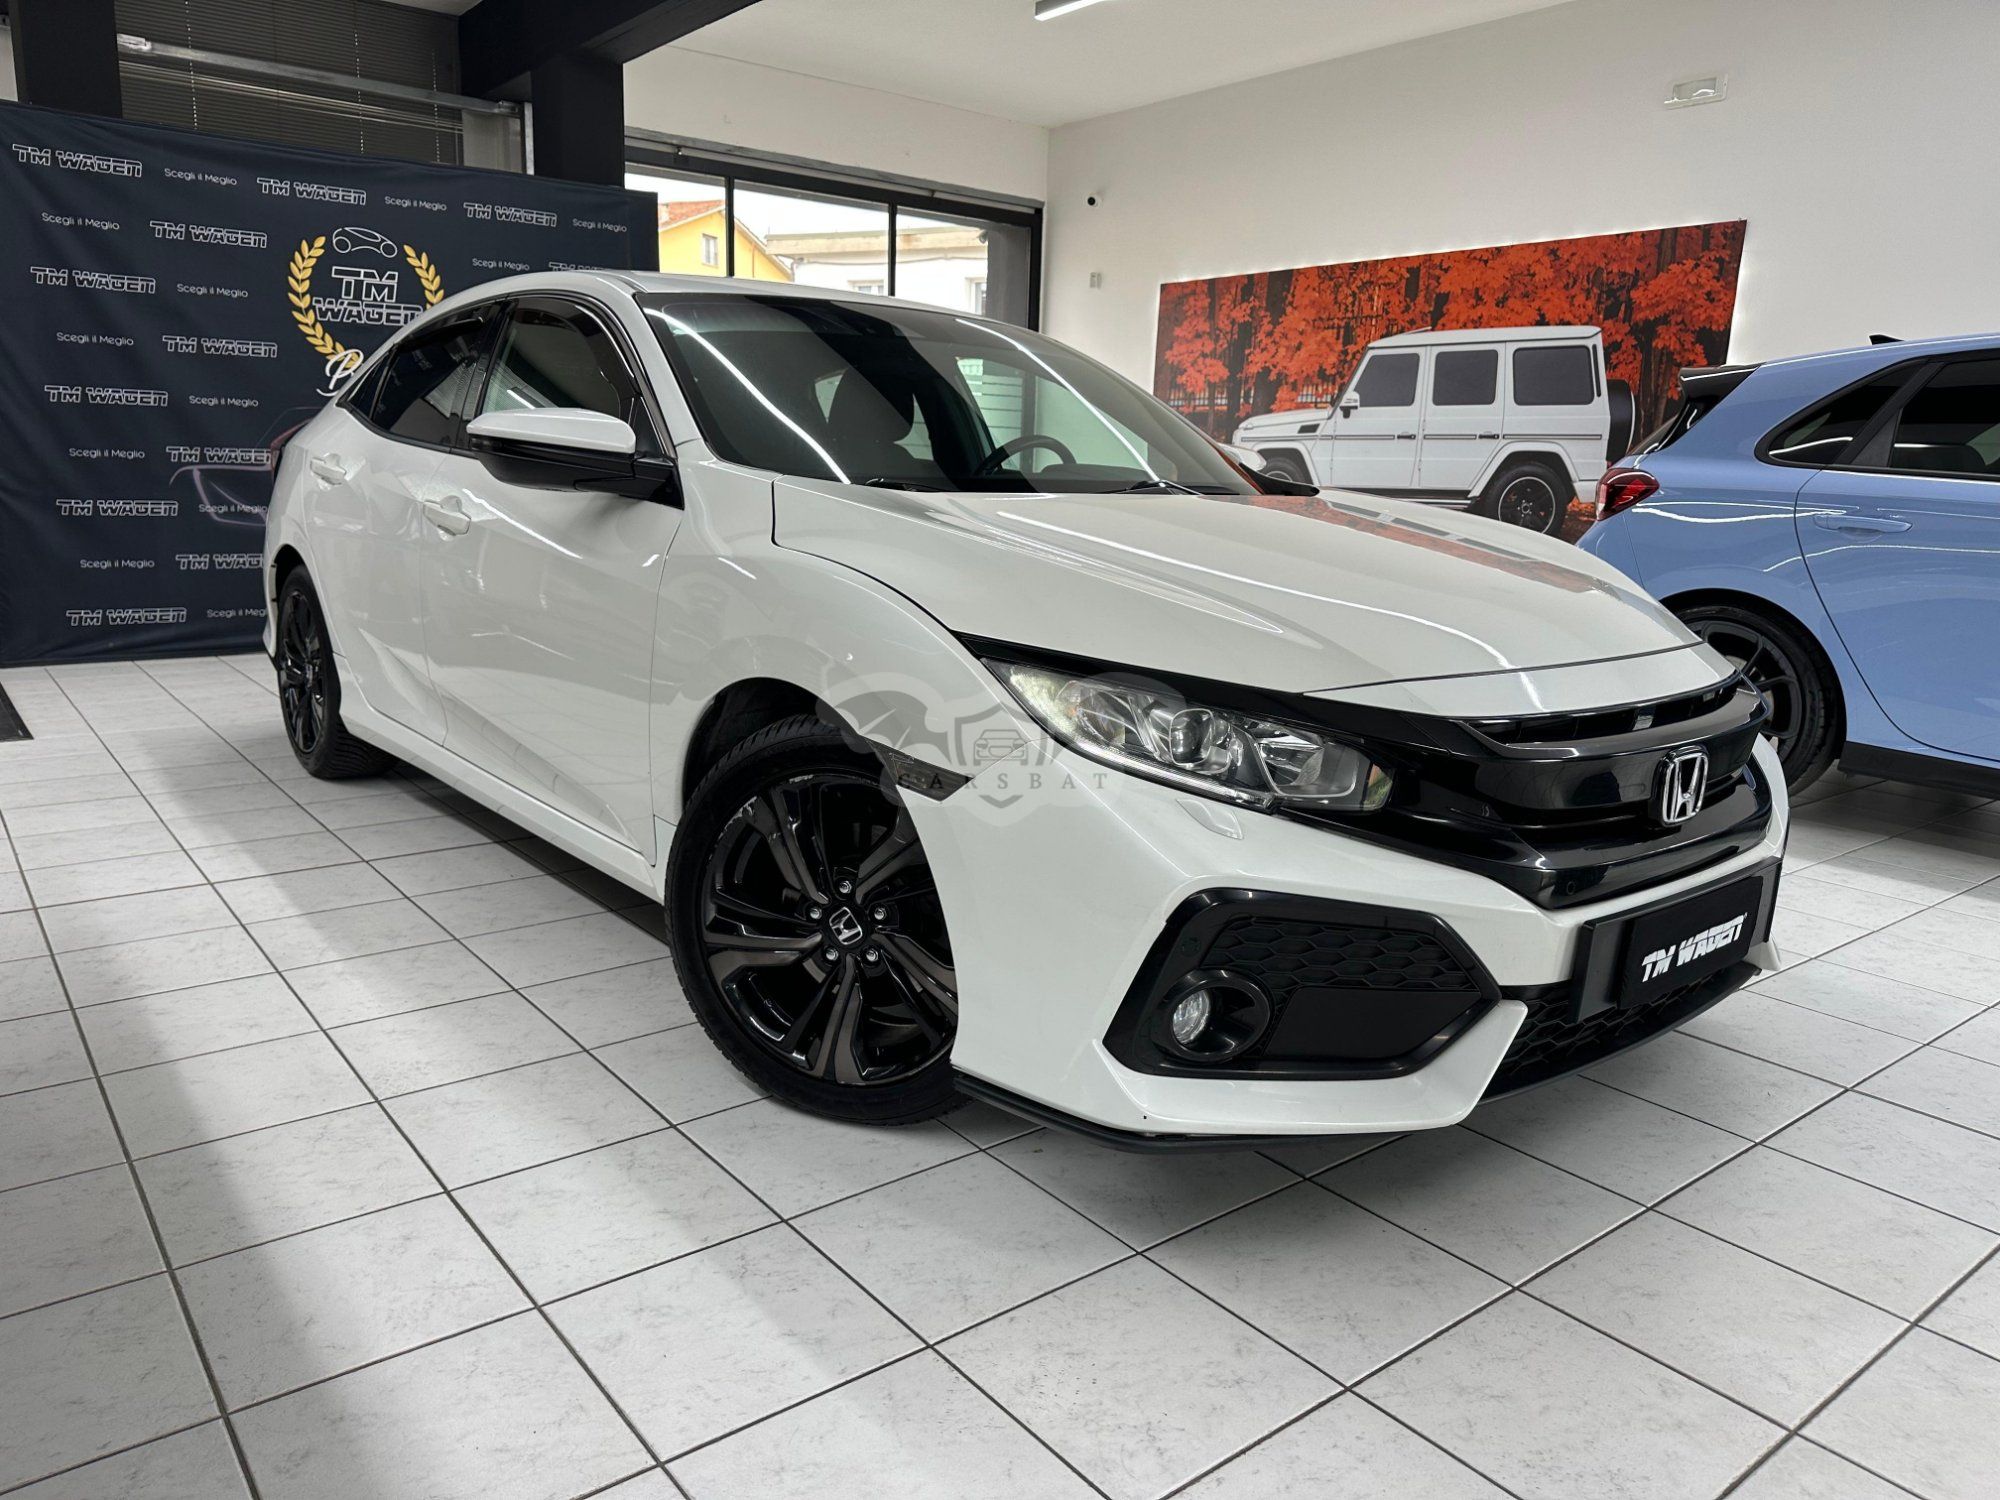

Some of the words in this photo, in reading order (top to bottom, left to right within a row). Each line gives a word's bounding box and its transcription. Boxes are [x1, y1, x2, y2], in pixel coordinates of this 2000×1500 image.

[12, 144, 51, 166] TM
[56, 150, 142, 177] WAGEN
[165, 168, 195, 181] Scegli
[205, 174, 237, 185] Meglio
[257, 177, 290, 196] TM
[294, 182, 366, 205] WAGEN
[385, 196, 411, 207] Scegli
[419, 201, 447, 211] Meglio
[42, 212, 74, 225] Scegli
[85, 219, 119, 230] Meglio
[463, 202, 492, 219] TM
[494, 206, 557, 227] WAGEN
[573, 219, 596, 229] Scegli
[602, 223, 627, 232] Meglio
[150, 221, 185, 240] TM
[189, 225, 267, 248] WAGEN
[473, 258, 497, 268] Scegli
[504, 262, 530, 271] Meglio
[30, 267, 68, 286] TM
[72, 270, 156, 294] WAGEN
[331, 266, 399, 302] TM
[177, 284, 207, 295] Scegli
[217, 288, 248, 298] Meglio
[57, 332, 89, 344] Scegli
[100, 336, 133, 346] Meglio
[162, 335, 197, 353] TM
[201, 338, 277, 358] WAGEN
[44, 385, 82, 403] TM
[86, 387, 168, 406] WAGEN
[189, 396, 219, 406] Scegli
[228, 398, 258, 407] Meglio
[69, 448, 101, 458] Scegli
[112, 450, 145, 459] Meglio
[166, 446, 200, 463] TM
[56, 499, 93, 516] TM
[97, 500, 178, 516] WAGEN
[199, 504, 228, 514] Scegli
[237, 504, 268, 514] Meglio
[80, 560, 111, 569] Scegli
[122, 560, 154, 568] Meglio
[175, 554, 209, 570] TM
[213, 553, 263, 569] WAG
[66, 610, 102, 626] TM
[106, 607, 187, 625] WAGEN
[207, 609, 236, 618] Scegli
[1641, 944, 1677, 983] TM
[1676, 914, 1744, 967] WAGEN
